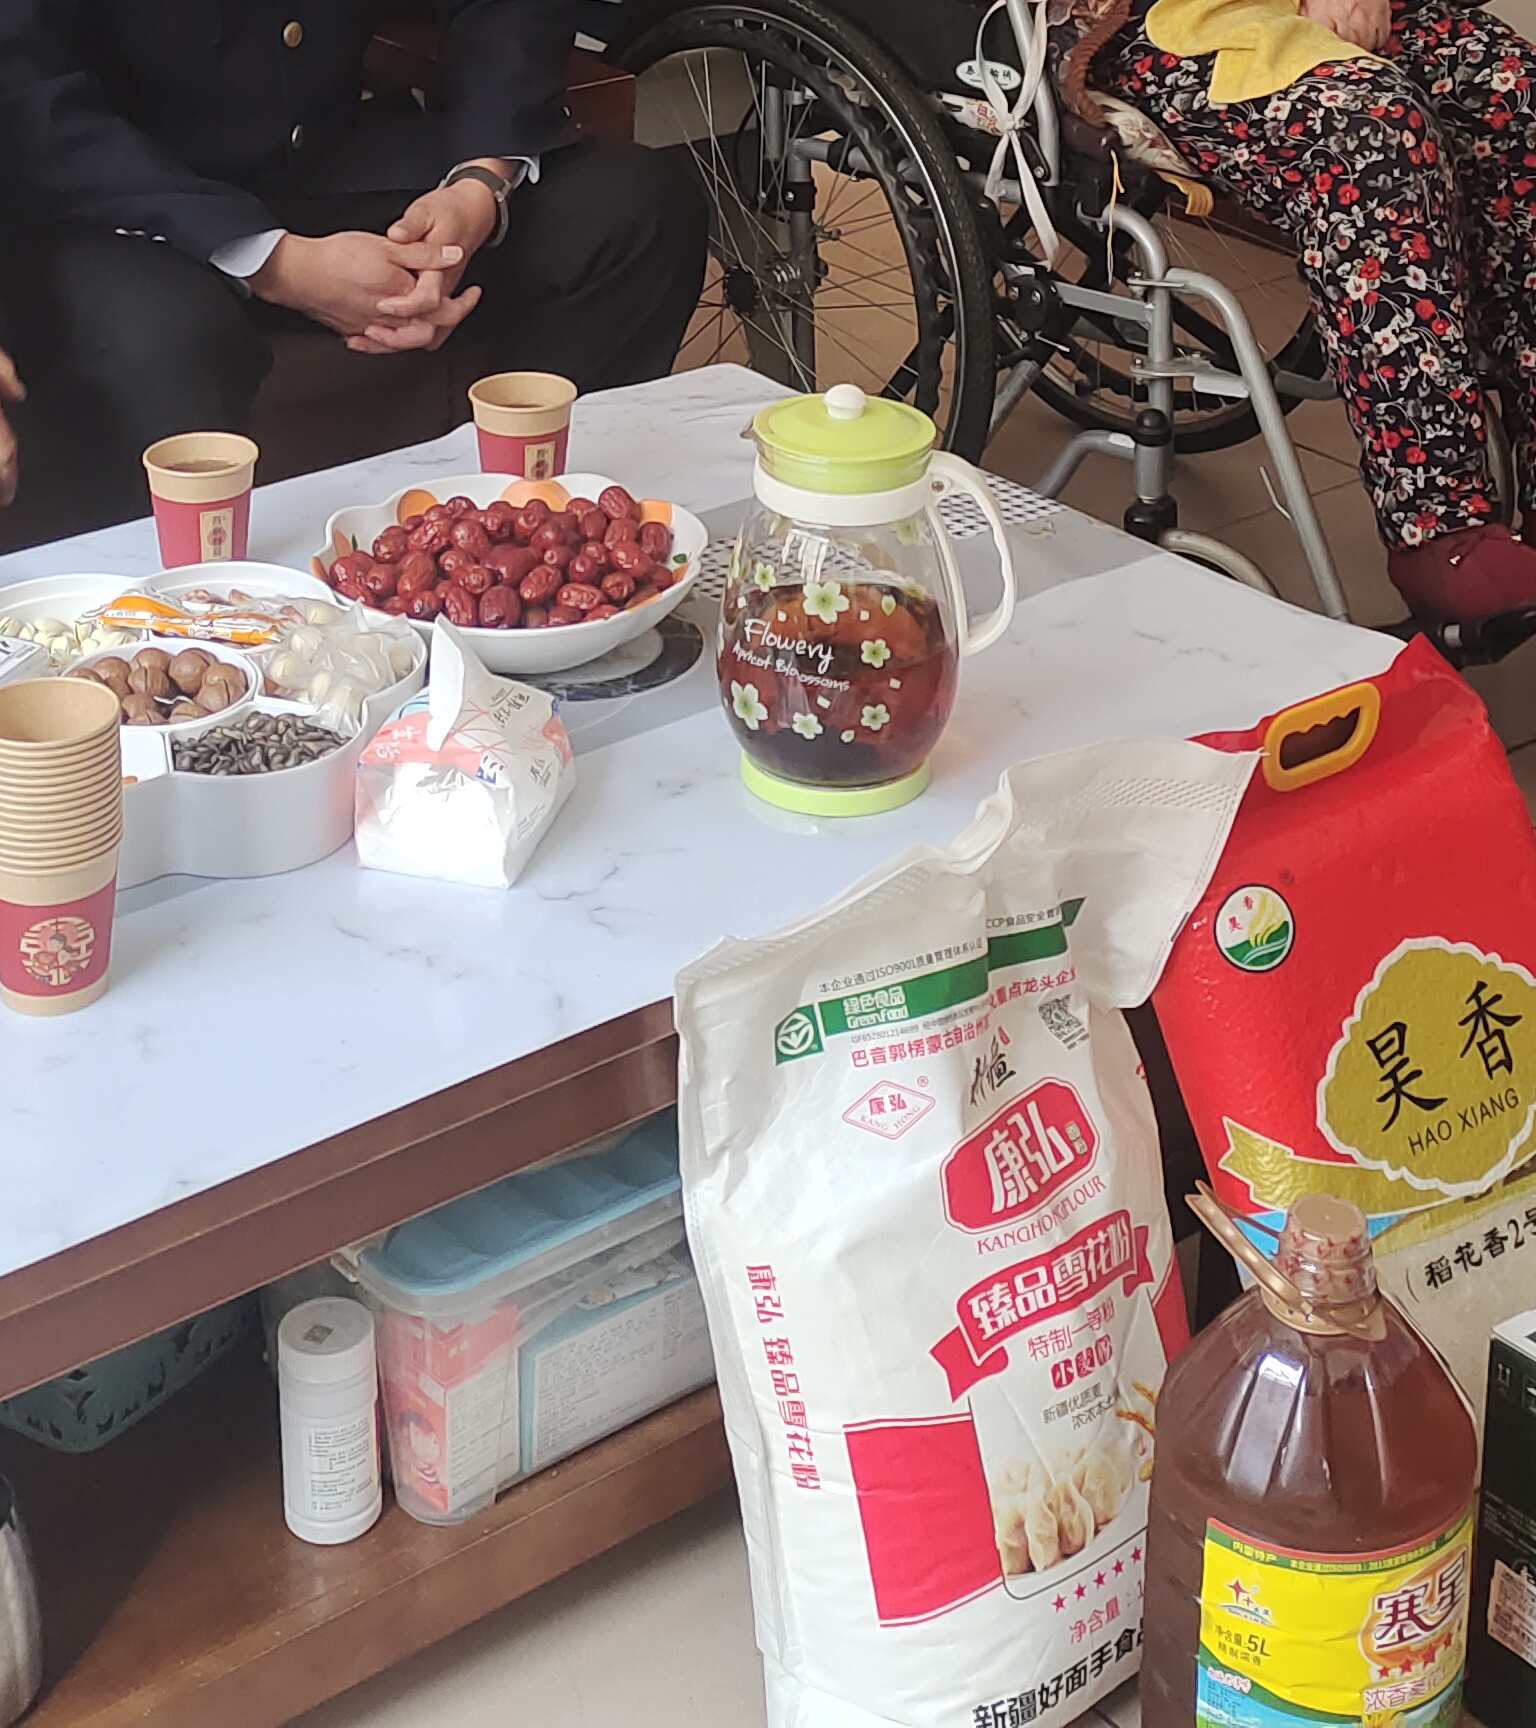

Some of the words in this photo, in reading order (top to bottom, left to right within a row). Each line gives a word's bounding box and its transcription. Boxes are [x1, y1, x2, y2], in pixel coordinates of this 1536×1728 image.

[743, 618, 835, 675] Flowery
[1366, 981, 1523, 1133] 昊香
[983, 1099, 1075, 1214] 康弘
[1407, 1118, 1452, 1157] HAO
[1460, 1086, 1521, 1134] XIANG
[967, 1215, 1133, 1342] 臻品雪花粉
